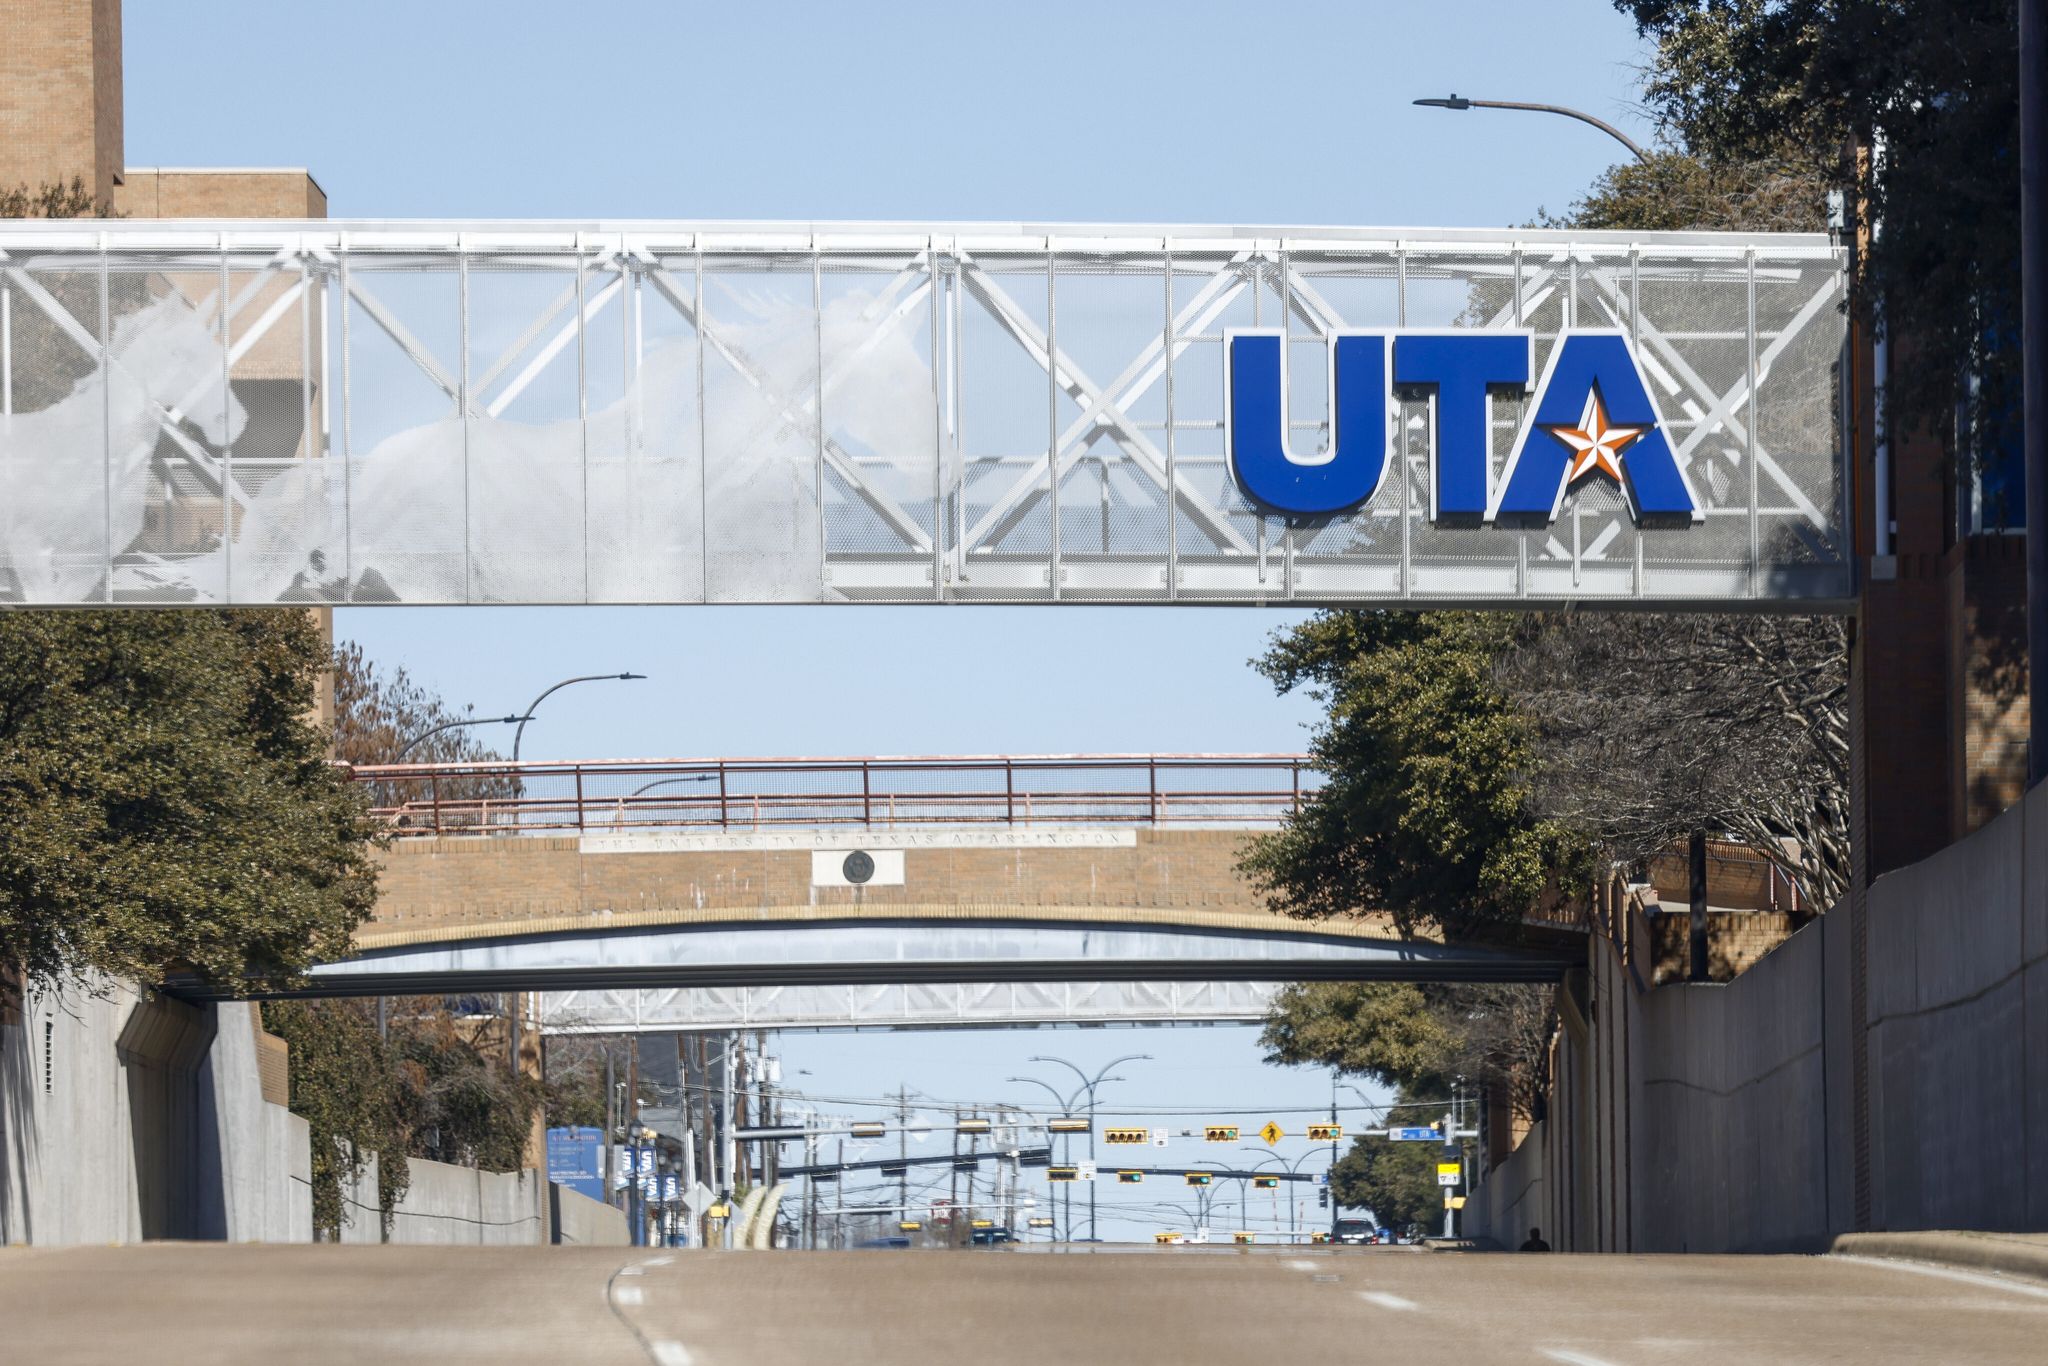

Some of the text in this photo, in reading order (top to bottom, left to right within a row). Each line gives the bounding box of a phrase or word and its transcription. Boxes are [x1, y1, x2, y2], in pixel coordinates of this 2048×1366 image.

[1224, 328, 1704, 526] UTA
[598, 832, 1120, 849] THE UNIVERSITY OF TEXAS AT ARLINGTON
[640, 1150, 652, 1172] UTA
